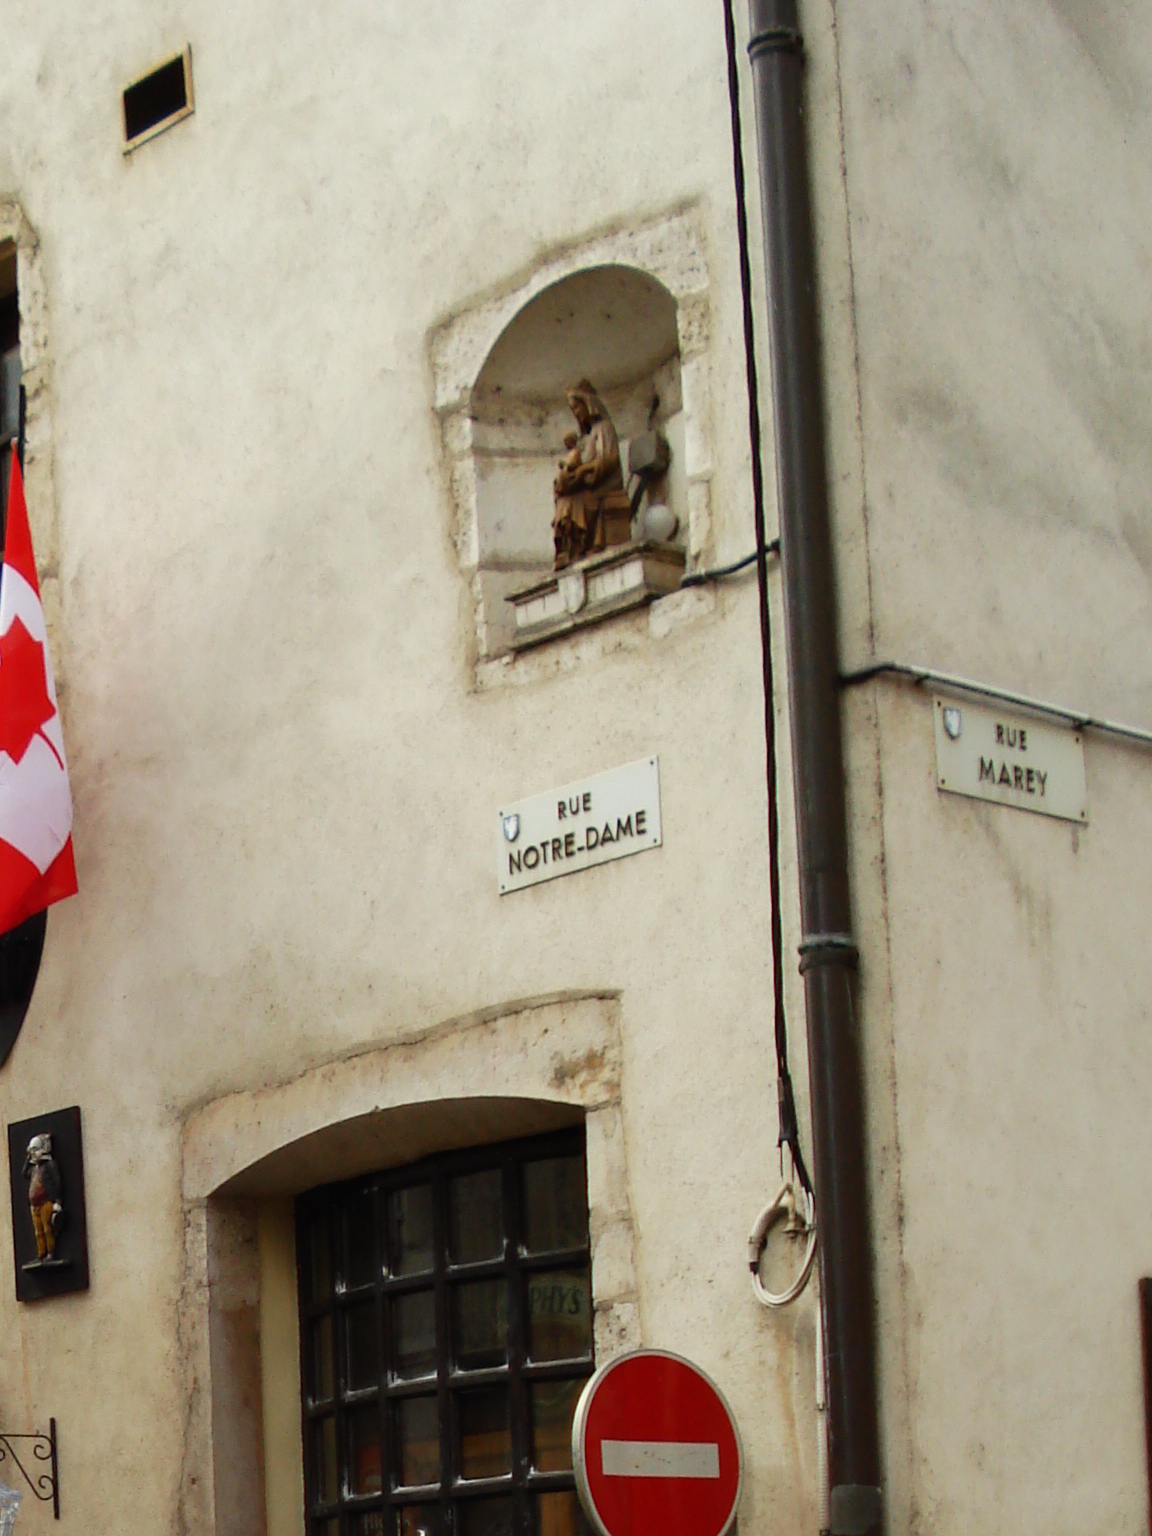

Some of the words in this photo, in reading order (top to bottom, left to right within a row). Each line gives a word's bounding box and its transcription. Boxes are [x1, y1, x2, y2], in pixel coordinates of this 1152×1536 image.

[996, 724, 1028, 751] RUE
[979, 755, 1048, 796] MAREY
[557, 791, 592, 820] RUE
[508, 809, 647, 875] NOTRE-DAME
